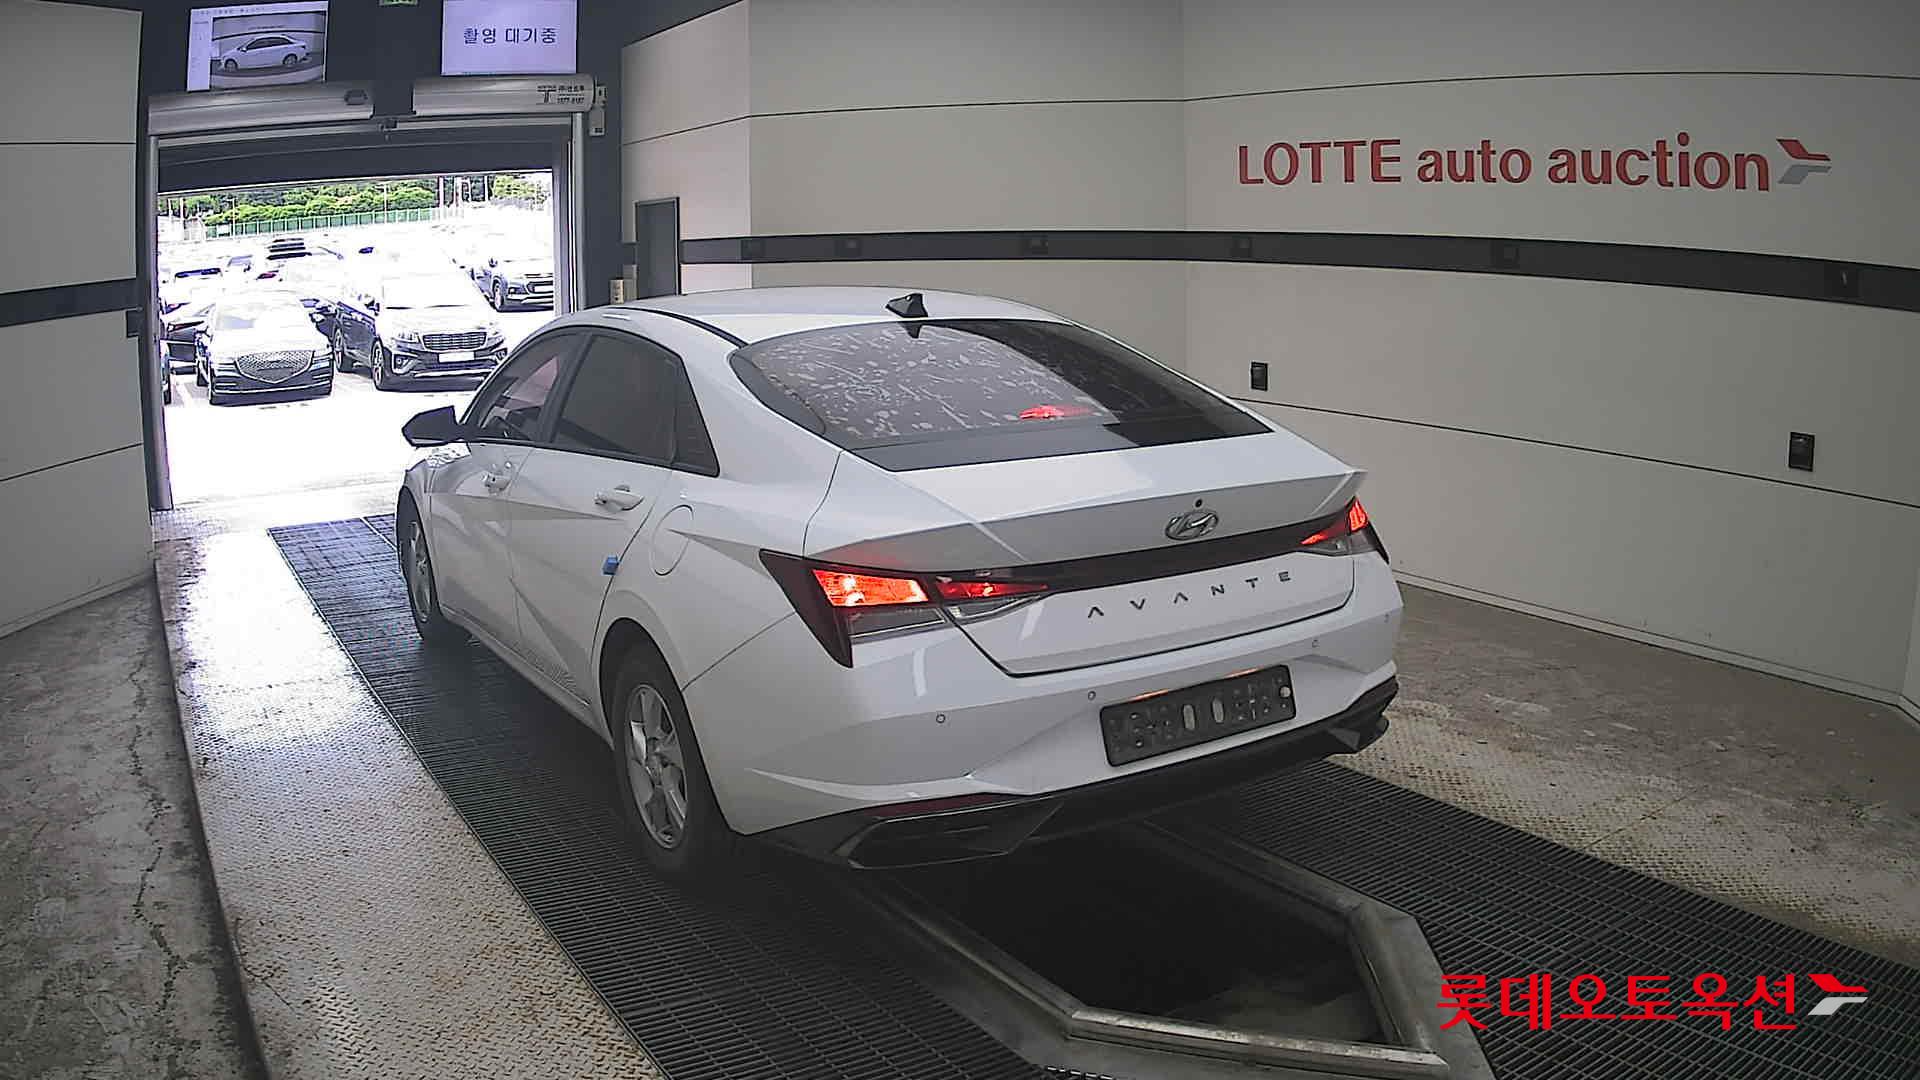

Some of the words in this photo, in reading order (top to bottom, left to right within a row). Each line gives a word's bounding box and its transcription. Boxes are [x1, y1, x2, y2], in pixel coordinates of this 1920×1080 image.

[463, 27, 496, 44] 촬영
[505, 27, 557, 44] 대기중
[1239, 139, 1401, 185] LOTTE
[1416, 139, 1532, 185] auto
[1547, 132, 1770, 192] auction
[1087, 570, 1291, 618] AVANTE
